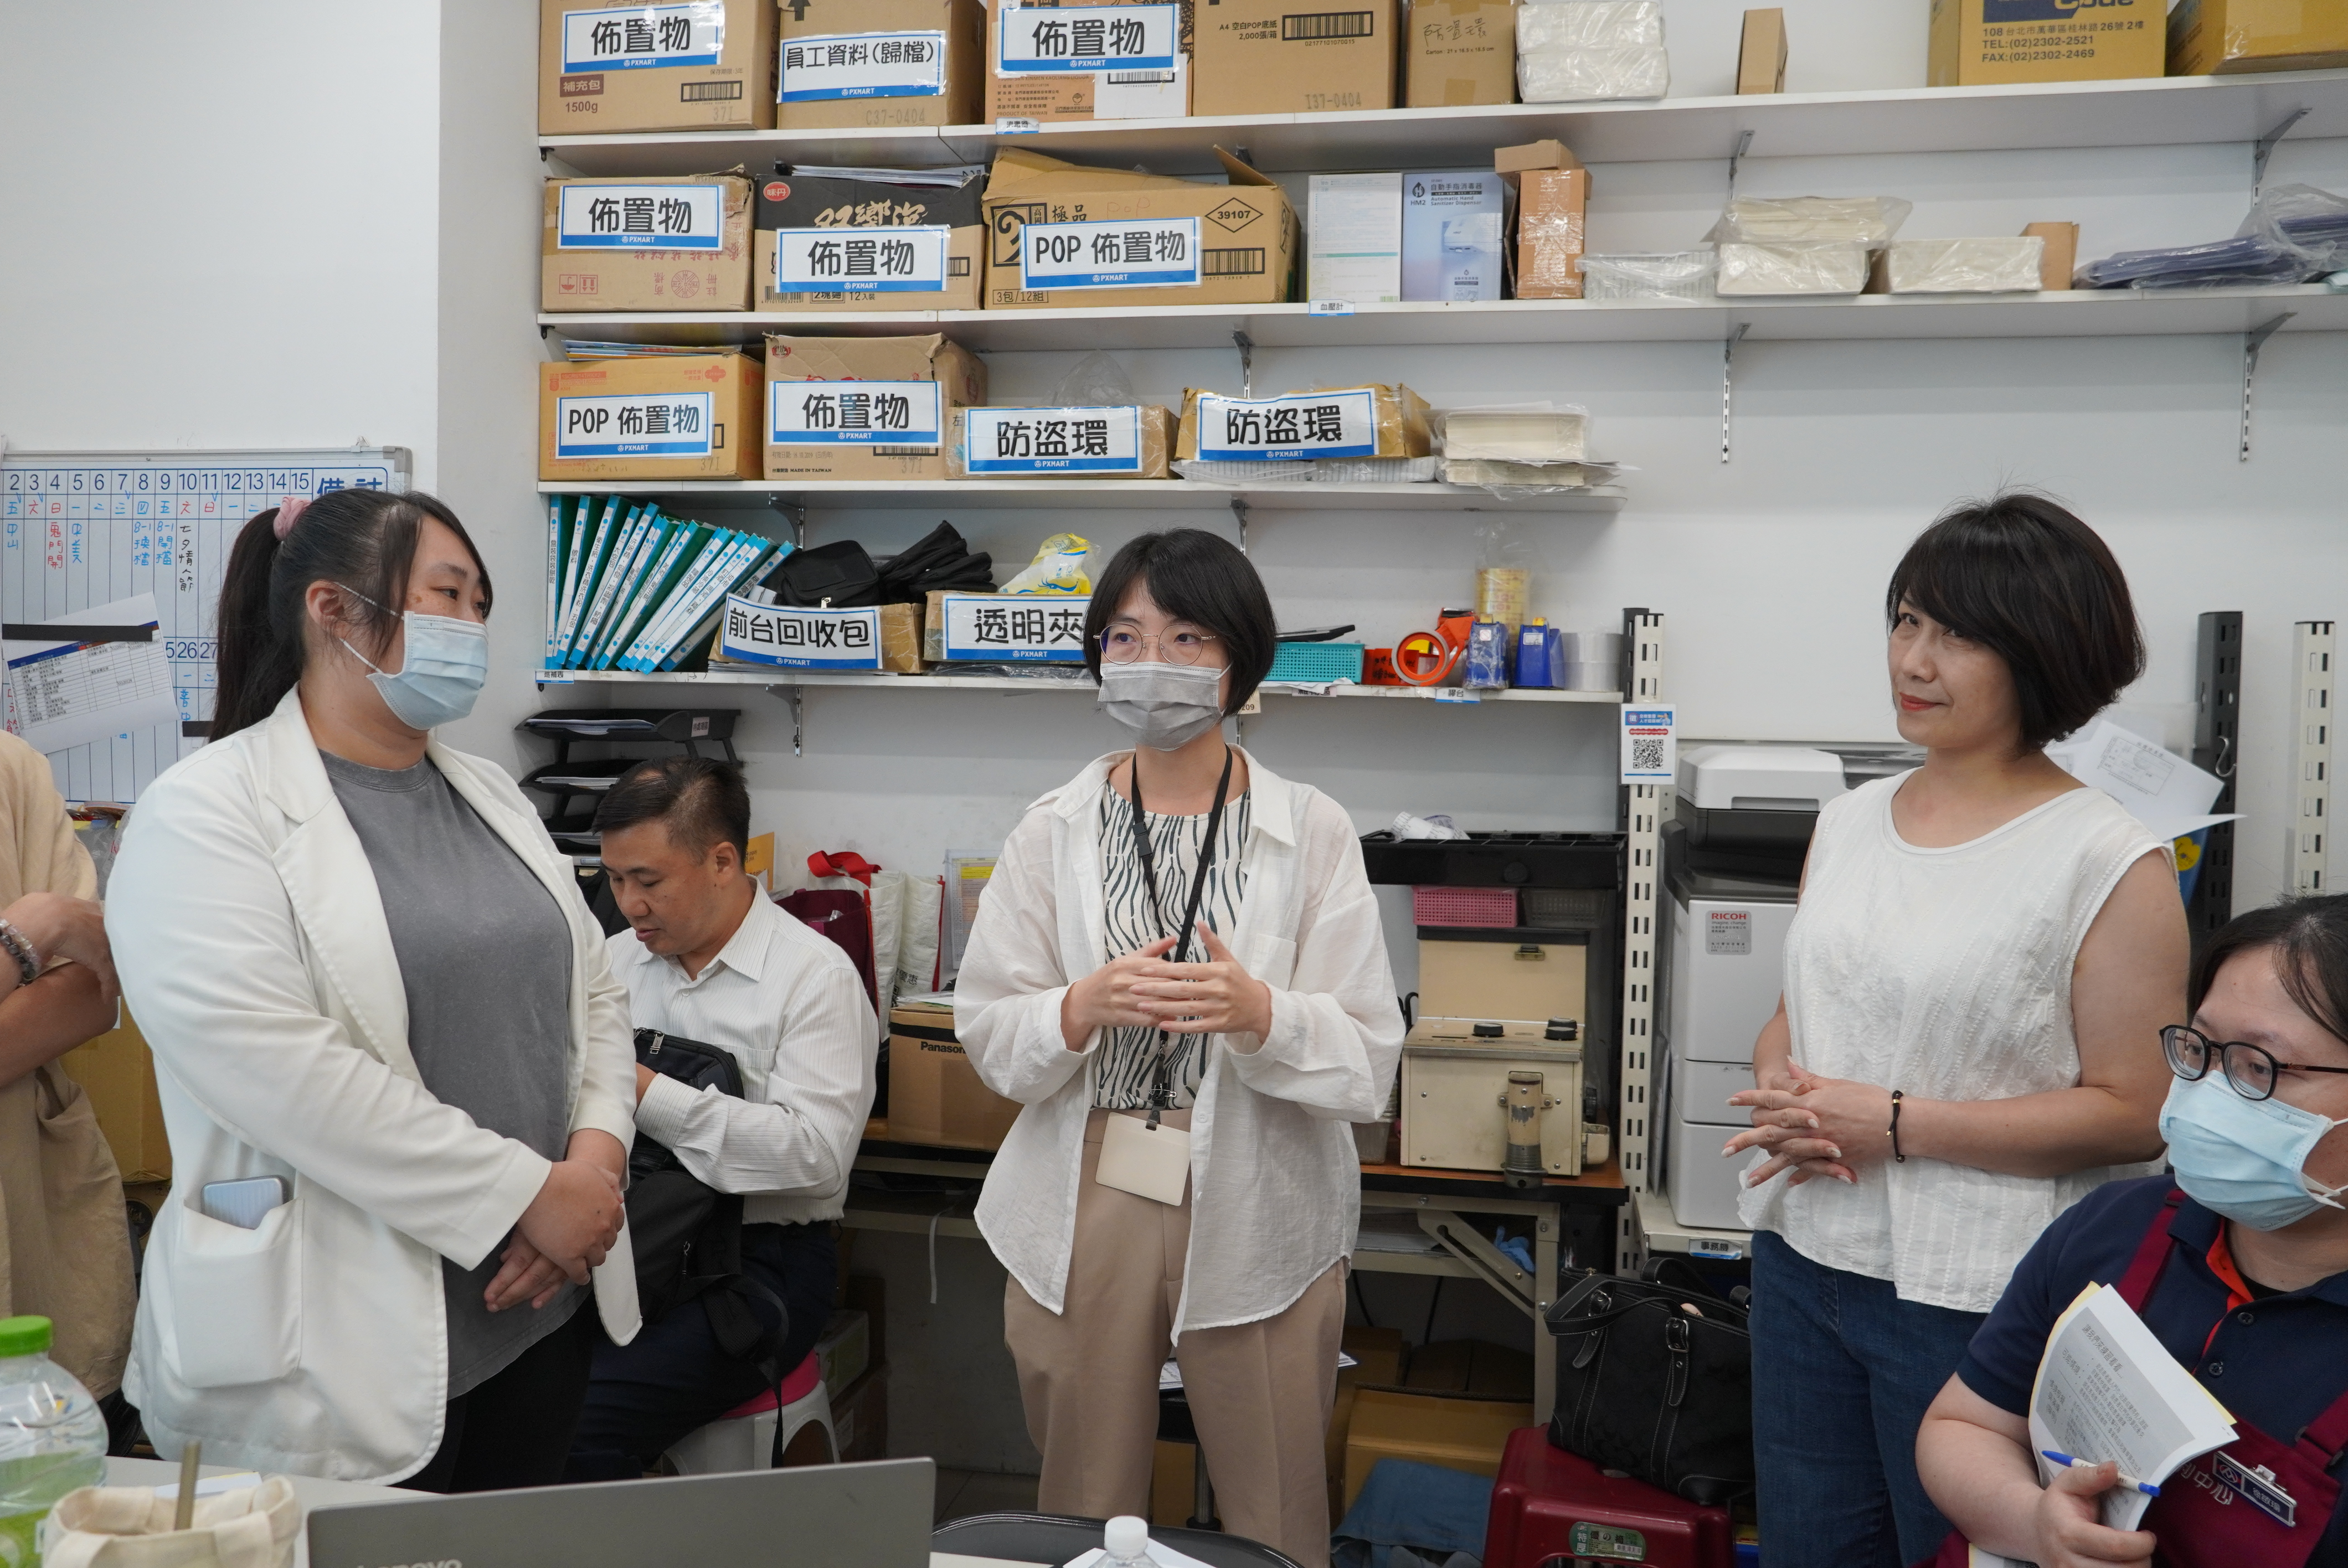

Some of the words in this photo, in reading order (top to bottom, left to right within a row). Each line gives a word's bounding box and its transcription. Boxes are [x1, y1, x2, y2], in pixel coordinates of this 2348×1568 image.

[1232, 20, 1277, 30] 空白POP底紙
[1983, 28, 2002, 37] 108
[591, 16, 690, 55] 佈置物
[1032, 18, 1145, 57] 佈置物
[1239, 30, 1277, 40] 2,000張/箱
[1982, 35, 2094, 49] TEL:(02)2302-2521
[786, 41, 934, 70] 員工資料(歸檔)
[1982, 49, 2094, 63] FAX:(02)2302-2469
[563, 80, 600, 91] 補充包
[565, 101, 598, 113] 1500g
[866, 108, 925, 126] C37-0404
[767, 188, 787, 197] 味丹
[589, 198, 692, 233] 佈置物
[1052, 205, 1087, 222] 極品
[1217, 210, 1250, 220] 39107
[1036, 235, 1080, 263] POP
[1091, 230, 1185, 264] 佈置物
[808, 240, 914, 276] 佈置物
[996, 291, 1044, 303] 3包/12組
[569, 409, 608, 434] POP
[617, 405, 699, 435] 佈置物
[802, 393, 909, 429] 佈置物
[1227, 405, 1342, 445] 防盜環
[997, 420, 1108, 457] 防盜環
[10, 474, 19, 490] 2
[29, 474, 39, 490] 3
[50, 474, 60, 490] 4
[73, 474, 83, 490] 5
[95, 474, 104, 490] 6
[118, 474, 127, 490] 7
[138, 473, 148, 490] 8
[161, 473, 170, 490] 9
[179, 473, 197, 490] 10
[202, 473, 217, 489] 11
[224, 473, 241, 489] 12
[246, 473, 264, 489] 13
[269, 473, 287, 489] 14
[291, 472, 310, 489] 15
[7, 502, 18, 514] 五
[28, 500, 38, 514] 六
[51, 503, 61, 513] 日
[115, 503, 125, 514] 三
[137, 501, 148, 514] 四
[159, 501, 170, 513] 五
[181, 501, 191, 514] 六
[204, 502, 214, 512] 日
[134, 522, 151, 533] 8-1
[157, 520, 174, 532] 8-1
[48, 522, 63, 570] 鬼門開
[133, 536, 150, 566] 換檔
[156, 535, 173, 565] 開檔
[178, 525, 194, 592] 七夕情人節
[570, 549, 579, 564] 飲料
[729, 607, 869, 648] 前台回收包
[974, 608, 1083, 644] 透明夾
[177, 642, 197, 659] 26
[200, 642, 218, 659] 27
[921, 1041, 966, 1054] Panason
